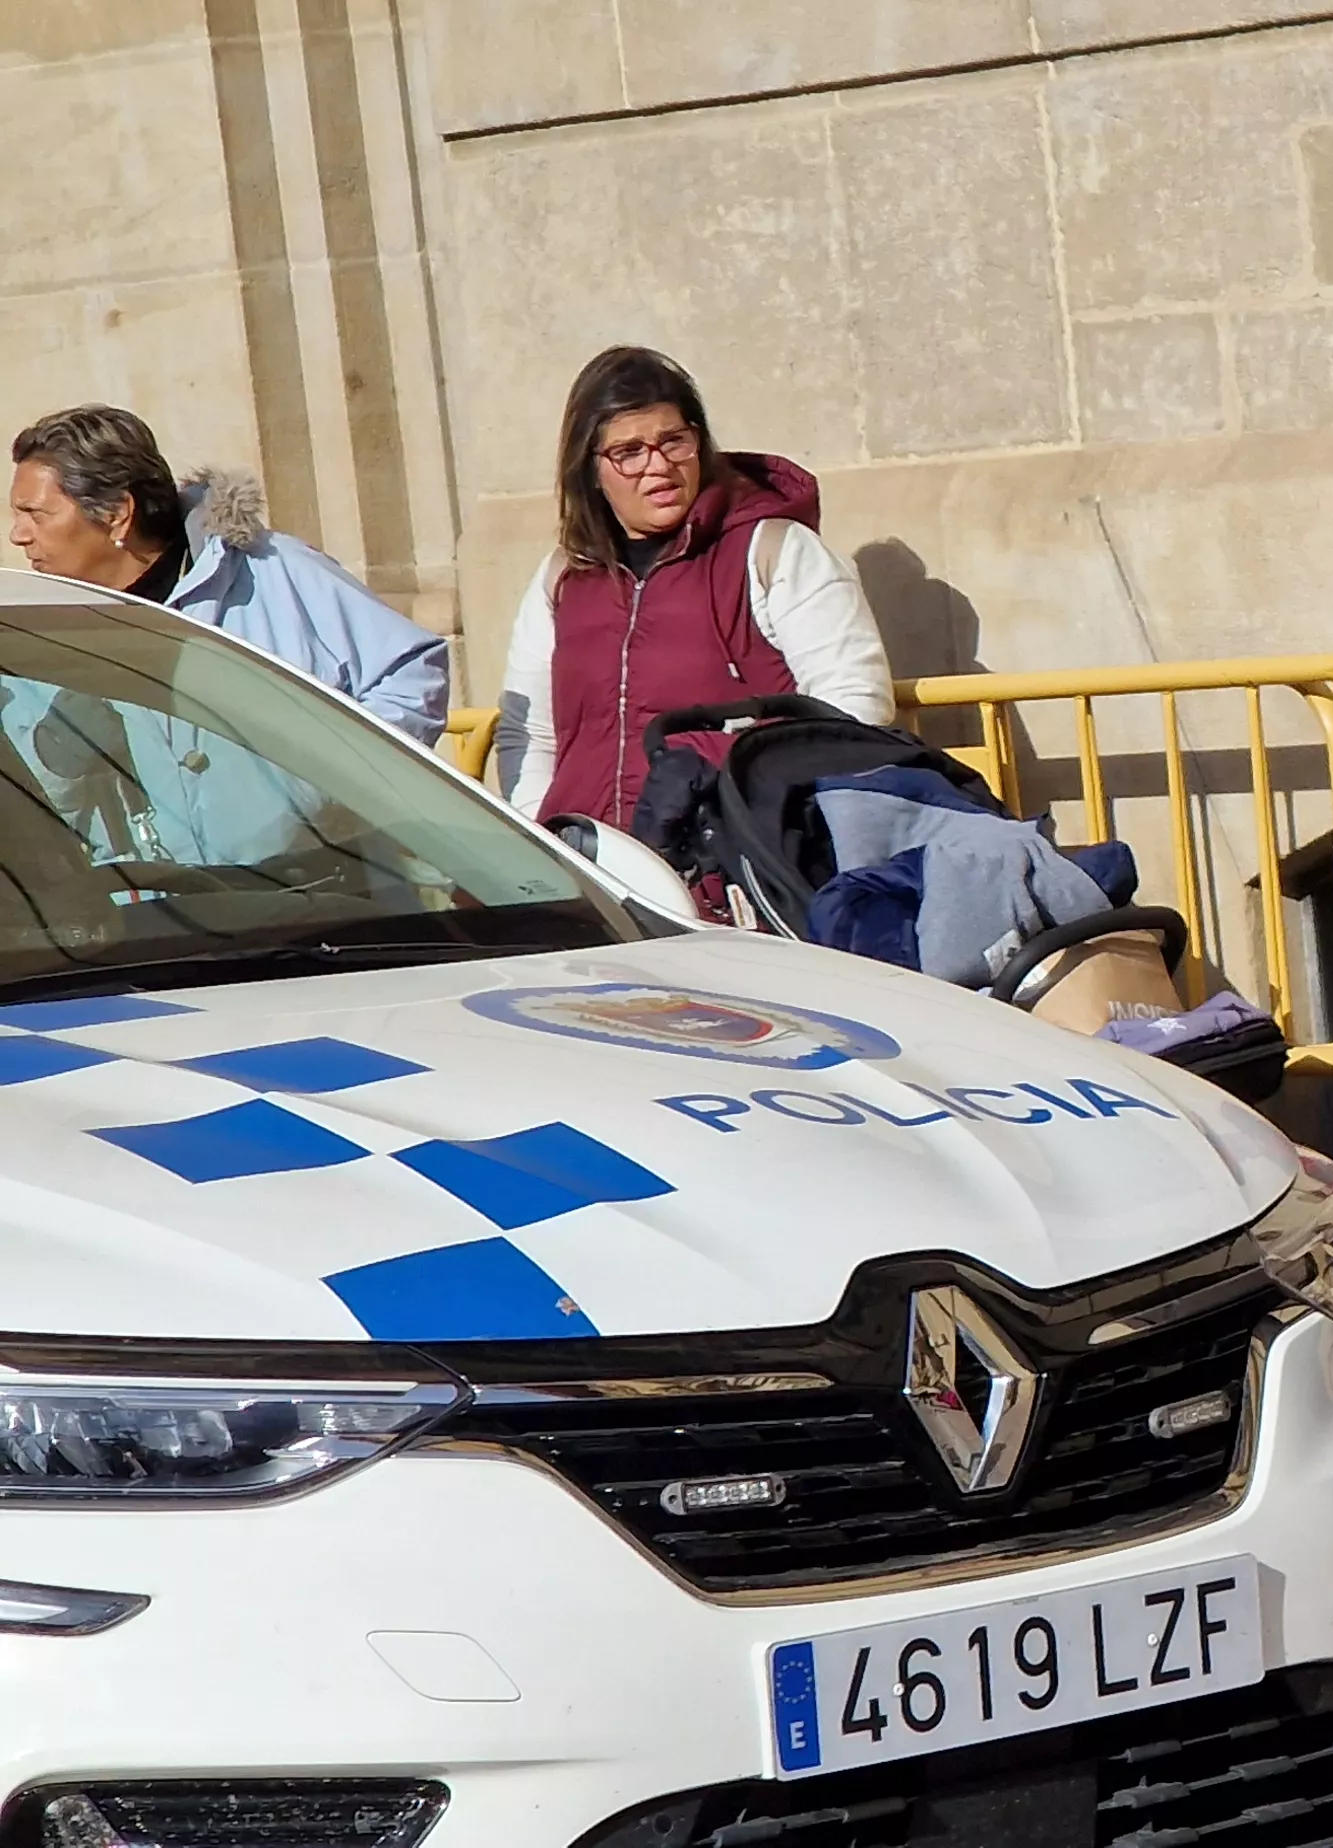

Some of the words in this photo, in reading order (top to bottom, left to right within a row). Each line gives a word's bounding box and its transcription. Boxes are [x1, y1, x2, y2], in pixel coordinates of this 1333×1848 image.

[652, 1077, 1181, 1133] POLICIA
[841, 1615, 1060, 1742] 4619
[1092, 1576, 1236, 1697] LZF
[790, 1720, 806, 1750] E
